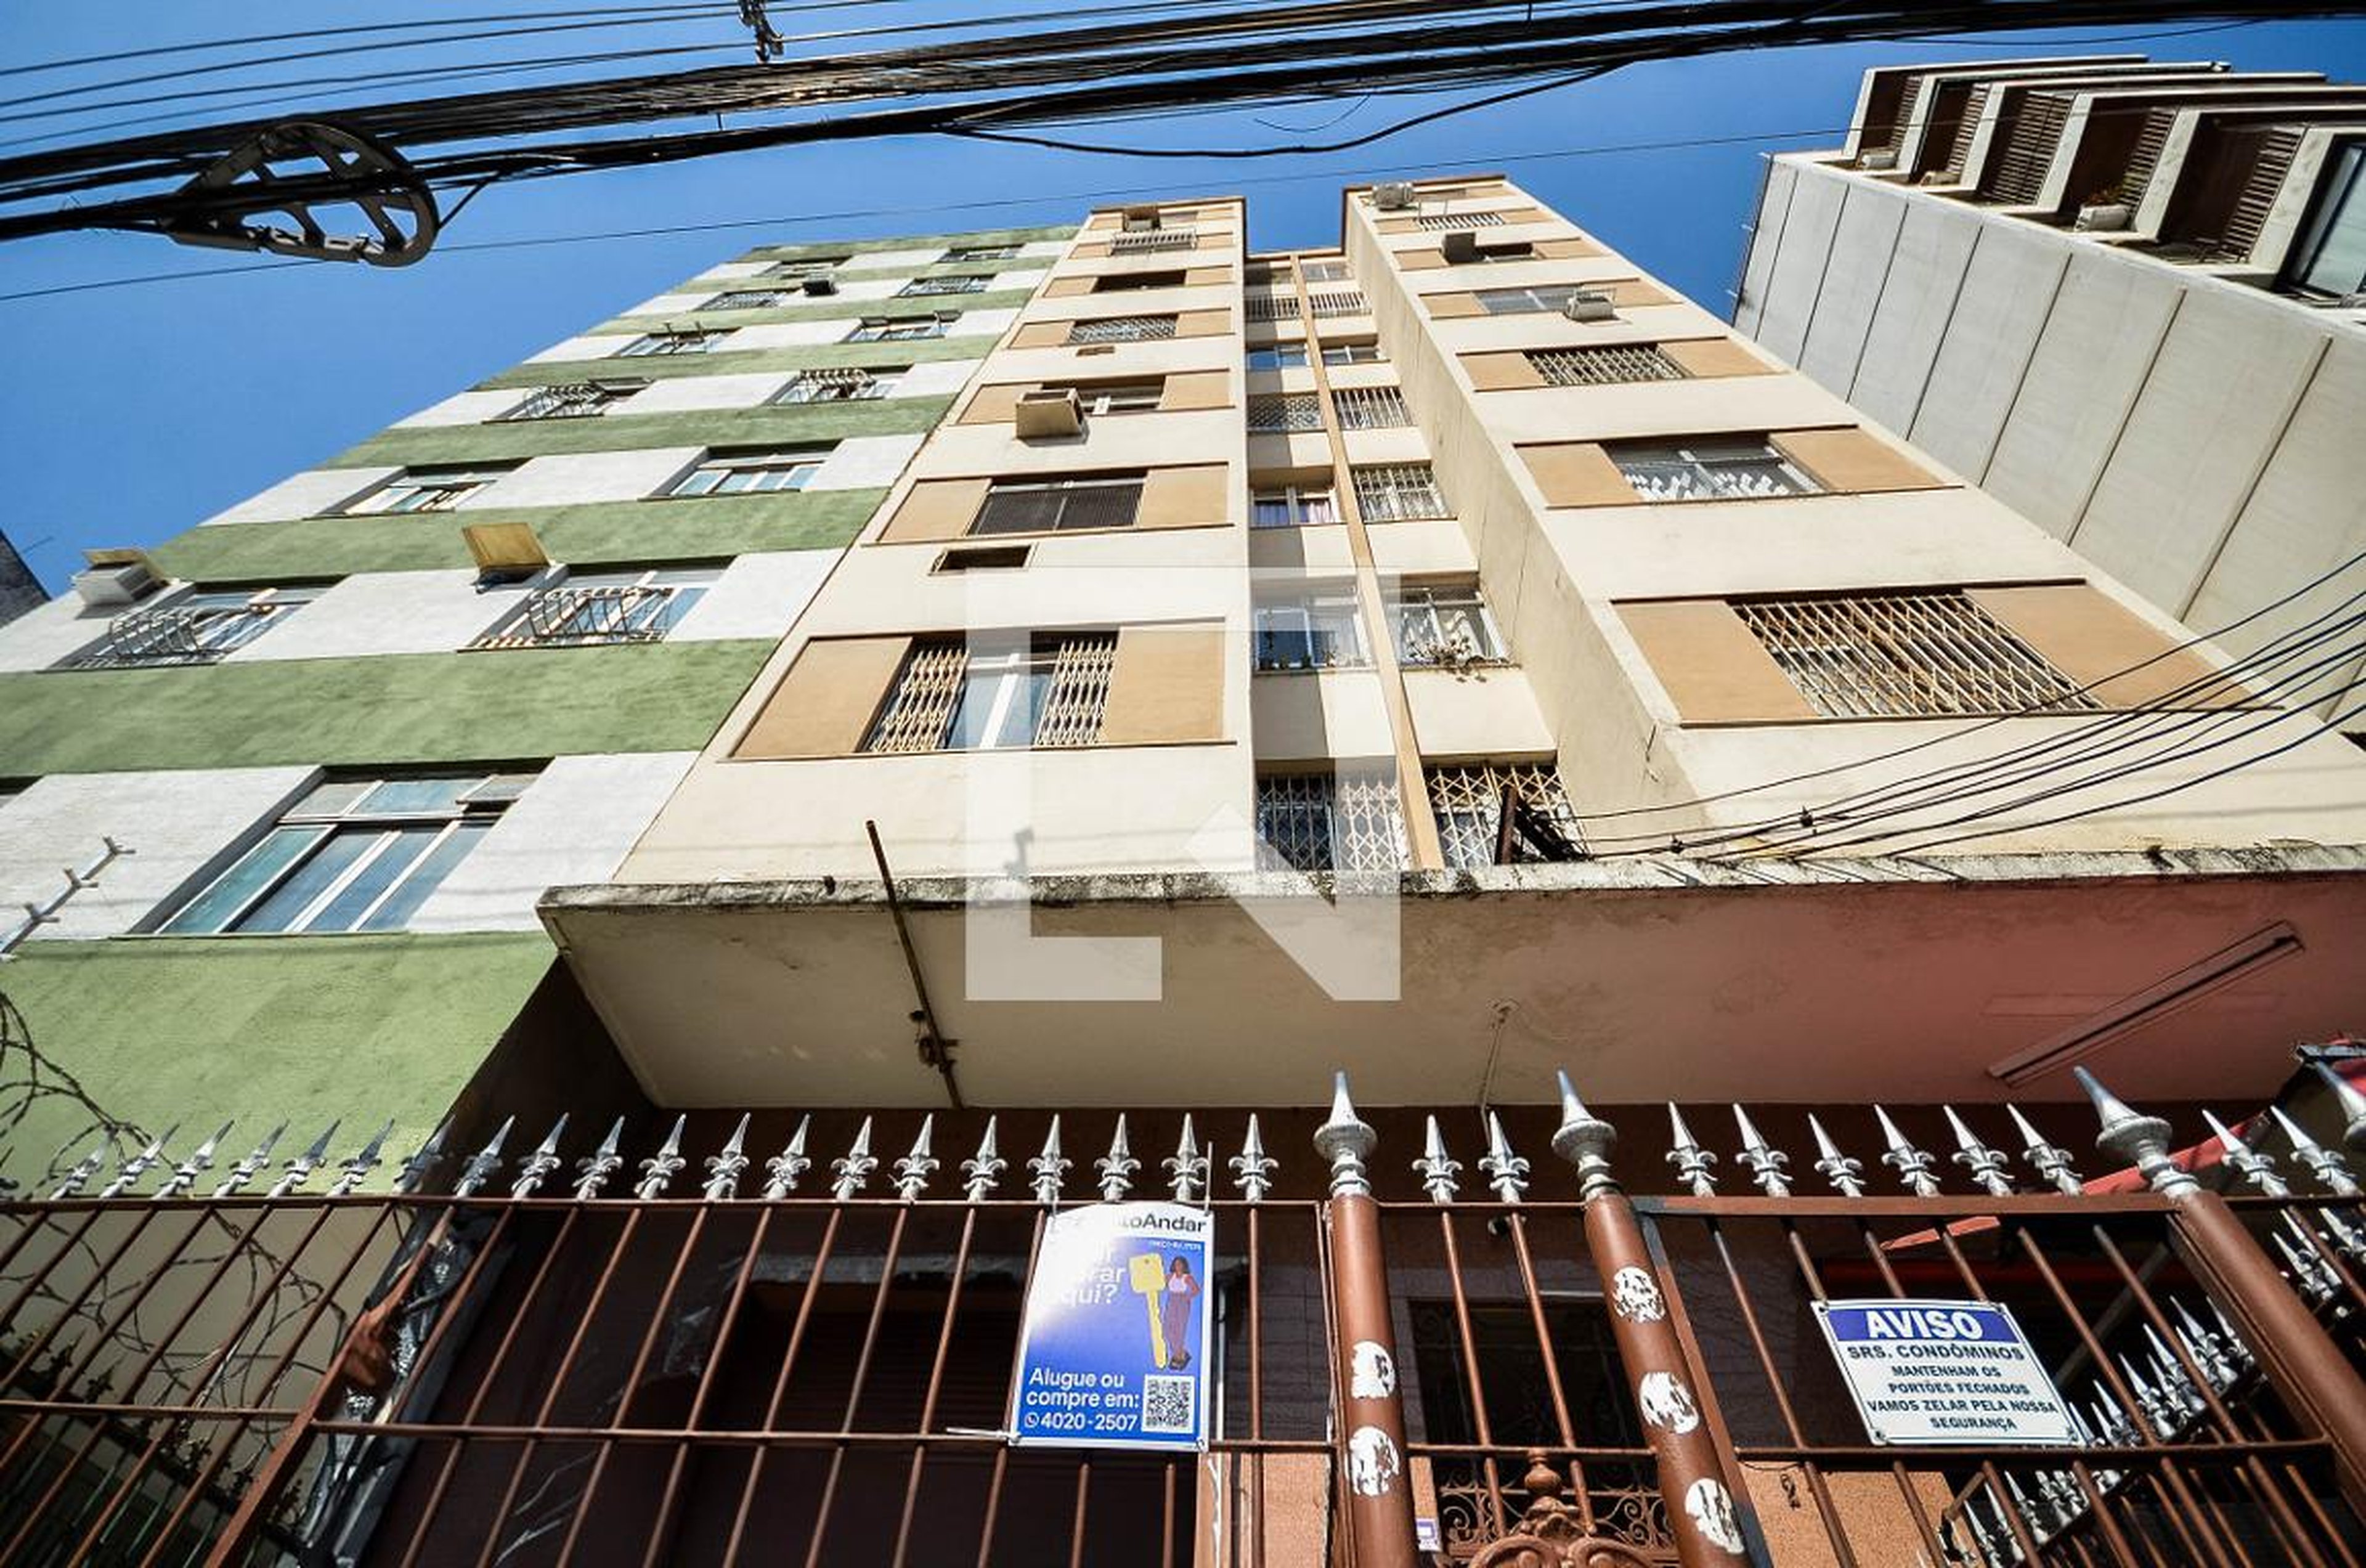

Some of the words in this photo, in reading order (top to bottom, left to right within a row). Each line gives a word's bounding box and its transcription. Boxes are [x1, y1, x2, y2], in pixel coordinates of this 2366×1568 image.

[1866, 1310, 1983, 1339] AVISO
[1847, 1345, 1893, 1360] SRS.
[1896, 1343, 2025, 1360] CONDÔMINOS
[1029, 1368, 1097, 1390] Alugue
[1100, 1374, 1124, 1387] ou
[1892, 1365, 1980, 1378] MANTENHAM
[1982, 1366, 2002, 1378] OS
[1888, 1379, 1954, 1394] PORTÕES
[1957, 1383, 2030, 1395] FECHADOS
[1026, 1390, 1104, 1410] compre
[1104, 1392, 1139, 1408] em:
[1867, 1399, 1919, 1412] VAMOS
[1922, 1399, 1967, 1412] ZELAR
[1972, 1399, 2007, 1412] PELA
[2009, 1400, 2059, 1414] NOSSA
[1930, 1416, 2017, 1432] SEGURANÇA
